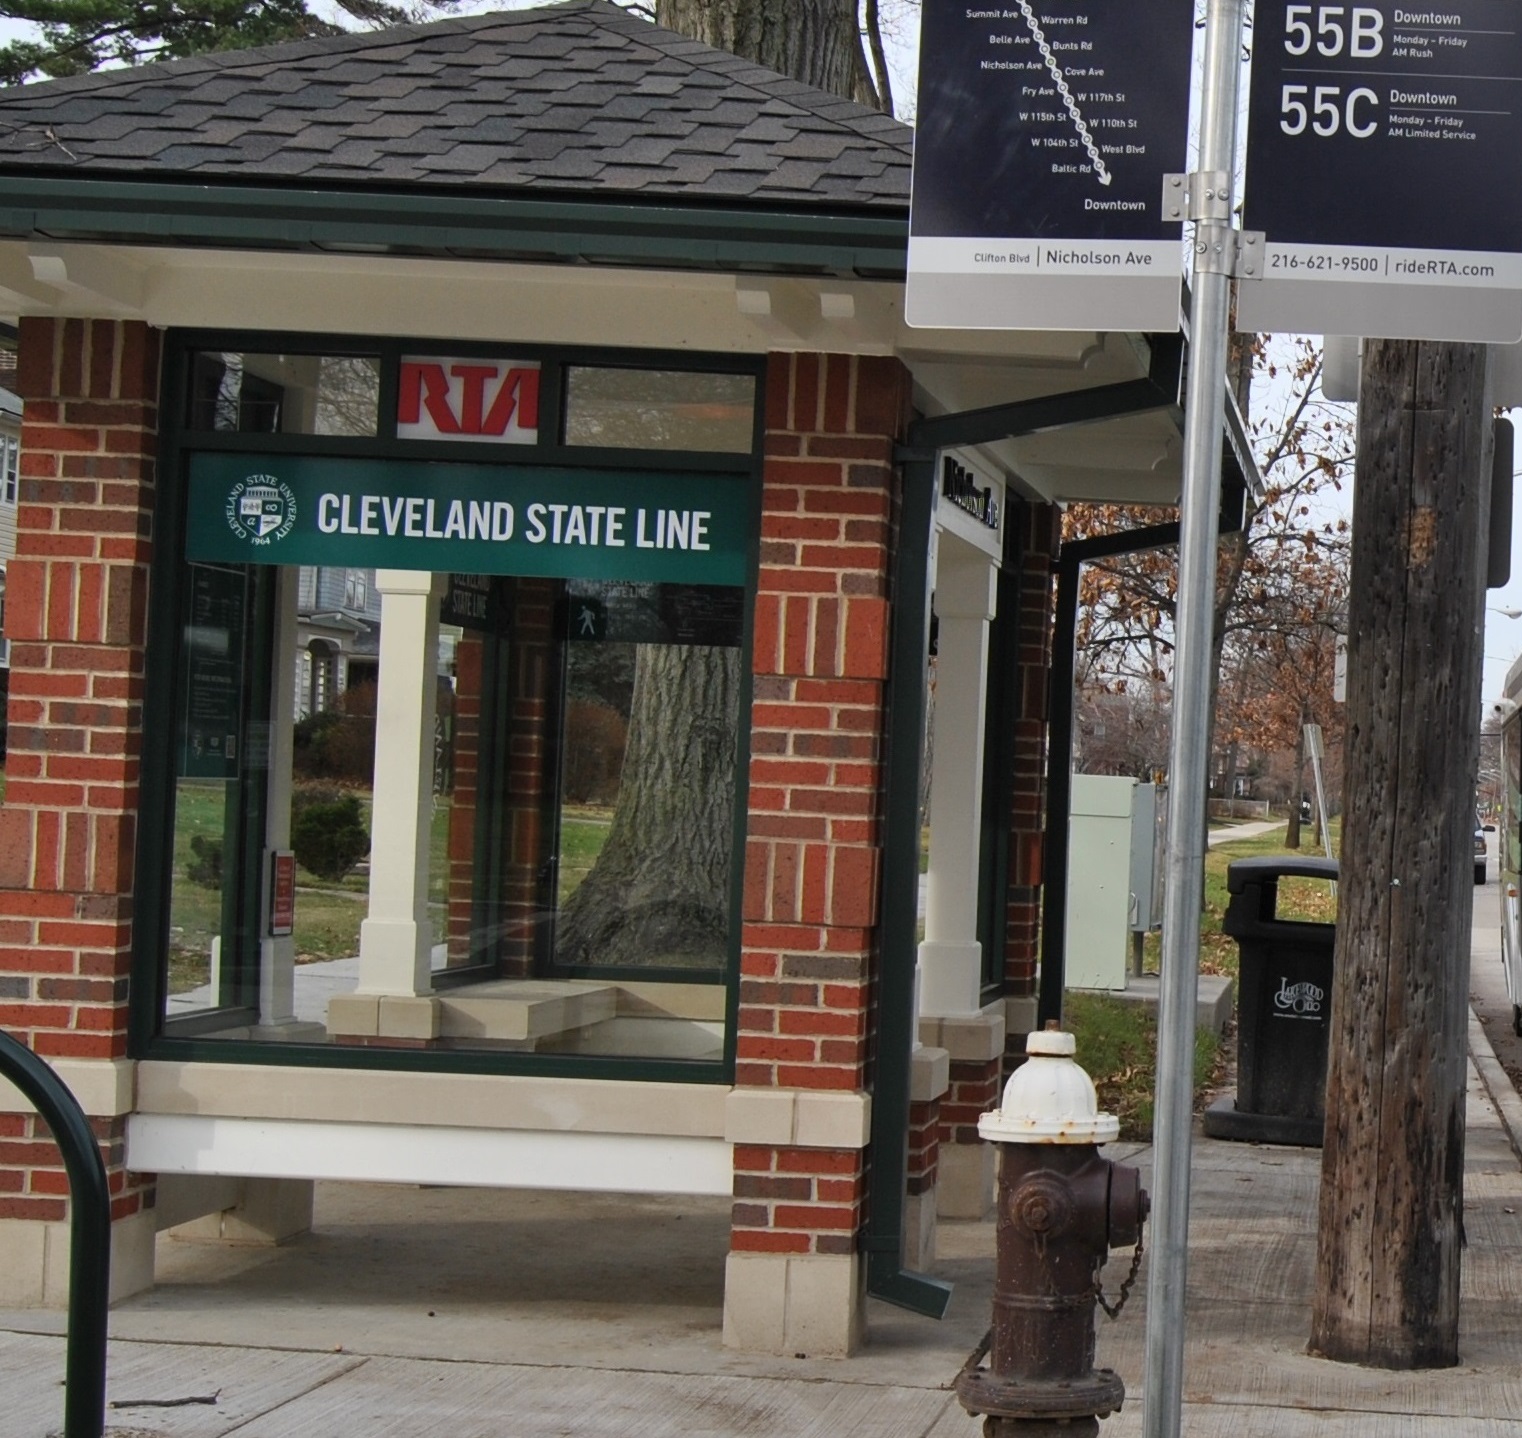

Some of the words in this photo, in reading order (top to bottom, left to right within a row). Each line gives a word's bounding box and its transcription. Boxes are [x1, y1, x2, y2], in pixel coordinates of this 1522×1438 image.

[966, 10, 1000, 19] Summit
[1002, 10, 1018, 19] Ave
[1394, 10, 1461, 26] Downtown
[1041, 16, 1074, 25] Warren
[1076, 16, 1088, 25] Rd
[1284, 5, 1384, 58] 55B
[989, 36, 1011, 44] Belle
[1014, 36, 1030, 44] Ave
[1393, 36, 1429, 46] Monday
[1438, 37, 1468, 48] Friday
[1053, 41, 1079, 50] Bunts
[1080, 42, 1092, 50] Rd
[1392, 48, 1408, 57] AM
[1410, 48, 1433, 58] Rush
[981, 61, 1025, 70] Nicholson
[1027, 61, 1042, 70] Ave
[1065, 67, 1086, 76] Cove
[1088, 67, 1104, 76] Ave
[1022, 87, 1037, 97] Fry
[1039, 87, 1054, 96] Ave
[1078, 93, 1087, 102] W
[1089, 93, 1113, 102] 117th
[1115, 94, 1125, 102] St
[1390, 90, 1457, 106] Downtown
[1280, 85, 1379, 138] 55C
[1019, 113, 1028, 121] W
[1031, 113, 1055, 121] 115th
[1057, 113, 1066, 122] St
[1389, 115, 1425, 126] Monday
[1434, 116, 1463, 128] Friday
[1090, 119, 1098, 128] W
[1101, 119, 1126, 128] 110th
[1127, 120, 1137, 128] St
[1388, 128, 1403, 137] AM
[1406, 128, 1440, 138] Limited
[1442, 129, 1476, 140] Service
[1031, 138, 1040, 147] W
[1043, 138, 1067, 147] 104th
[1069, 139, 1079, 147] St
[1102, 145, 1124, 154] West
[1126, 145, 1145, 154] Blvd
[1052, 164, 1076, 173] Baltic
[1079, 165, 1091, 173] Rd
[1084, 198, 1146, 211] Downtown
[974, 253, 1006, 263] Clifton
[1009, 253, 1030, 263] Blvd
[1046, 250, 1121, 265] Nicholson
[1125, 251, 1152, 265] Ave
[1271, 254, 1378, 272] 216-621-9500
[1395, 260, 1495, 278] rideRTA.com
[398, 363, 539, 435] RTA
[226, 483, 247, 539] CLEVELAND
[246, 474, 278, 485] STATE
[275, 483, 297, 540] UNIVERSITY
[317, 492, 514, 542] CLEVELAND
[526, 502, 626, 547] STATE
[636, 507, 712, 551] LINE
[251, 537, 270, 546] 1964
